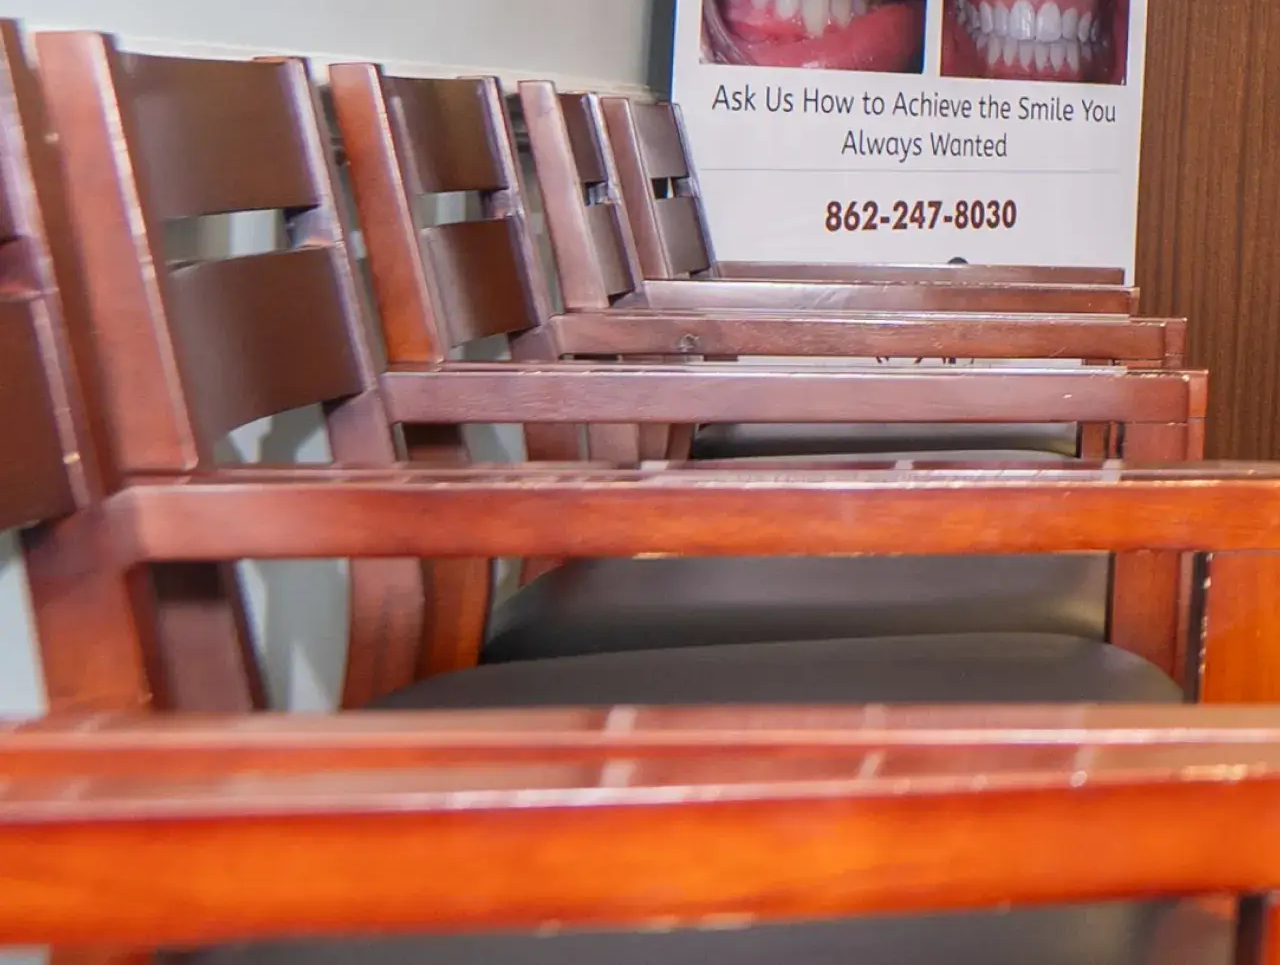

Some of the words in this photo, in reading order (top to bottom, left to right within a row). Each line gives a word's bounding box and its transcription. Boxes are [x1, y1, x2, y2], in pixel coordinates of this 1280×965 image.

[712, 84, 756, 112] Ask
[766, 87, 794, 113] Us
[803, 88, 854, 115] How
[862, 91, 885, 115] to
[892, 91, 972, 119] Achieve
[979, 93, 1011, 120] the
[1018, 96, 1074, 121] Smile
[1081, 99, 1116, 123] You
[841, 130, 922, 163] Always
[930, 133, 1007, 157] Wanted
[824, 199, 1017, 232] 862-247-8030
